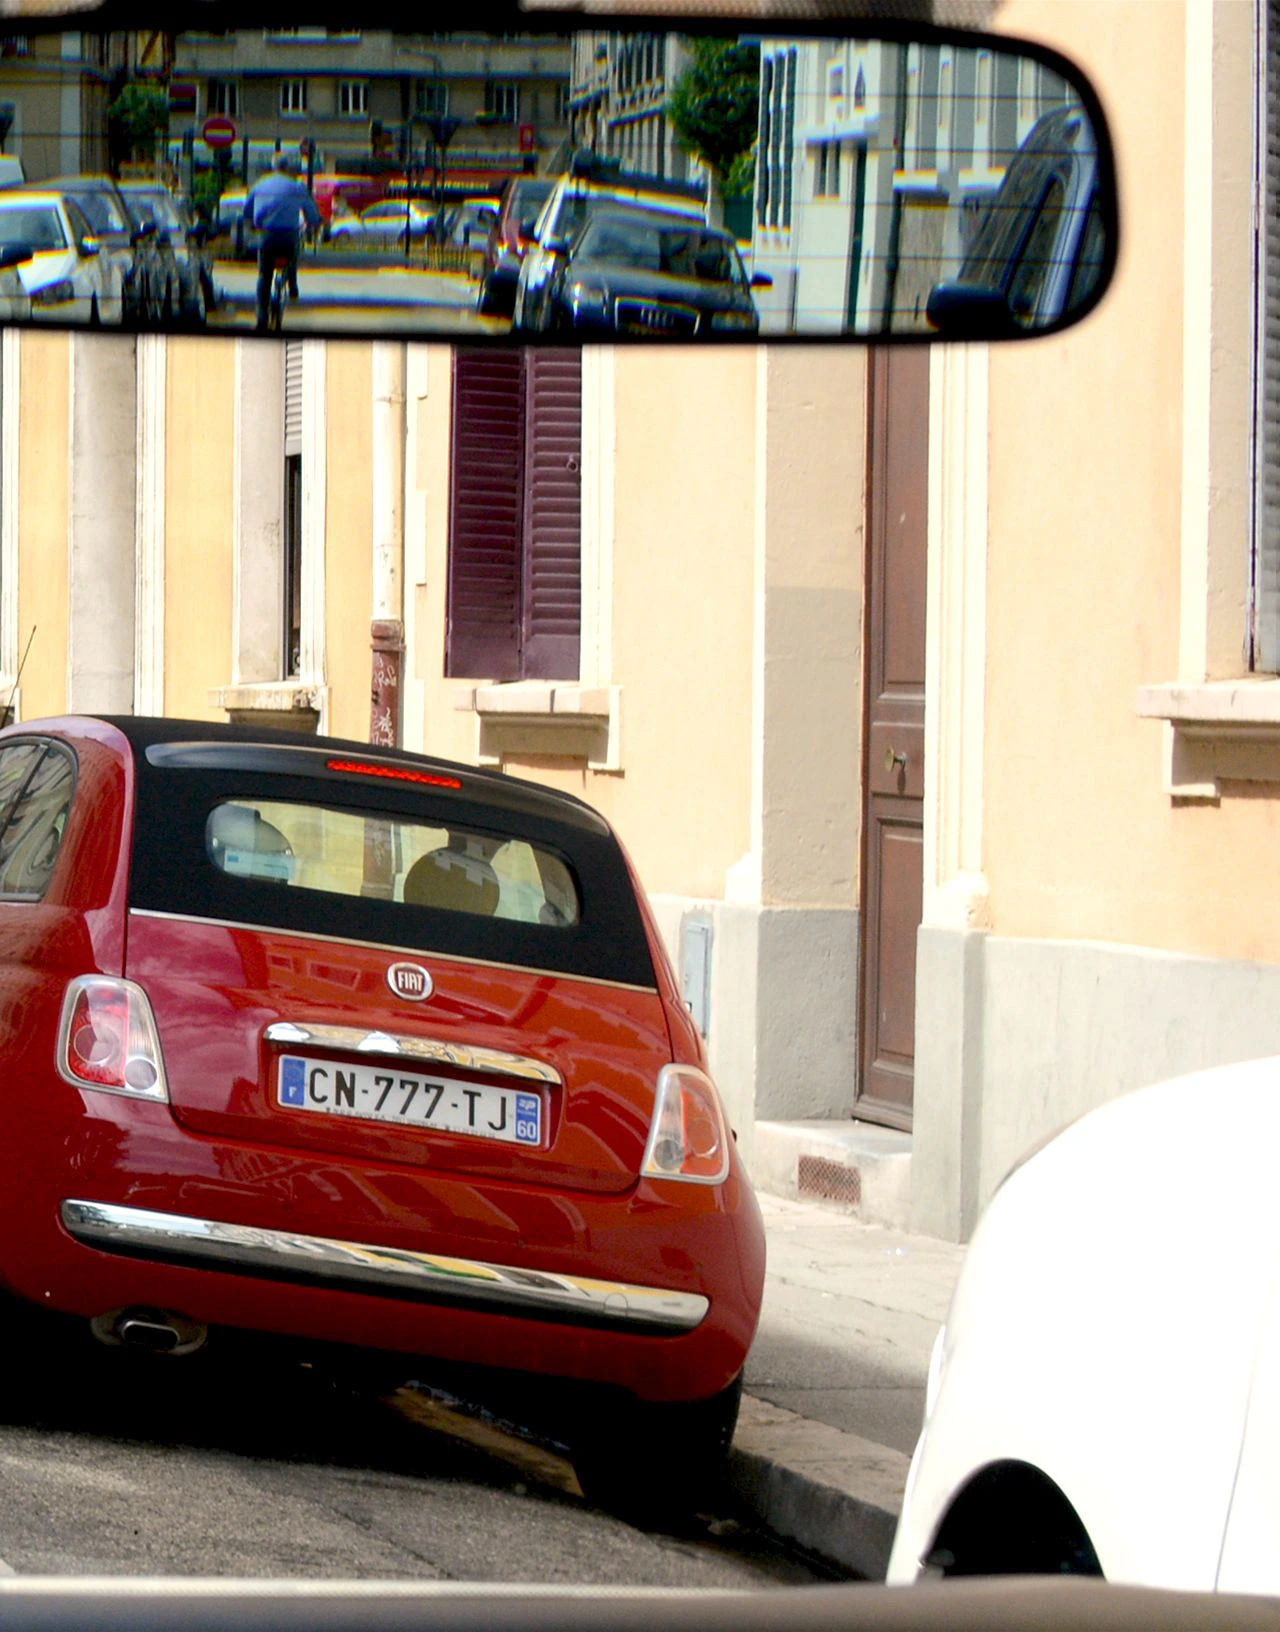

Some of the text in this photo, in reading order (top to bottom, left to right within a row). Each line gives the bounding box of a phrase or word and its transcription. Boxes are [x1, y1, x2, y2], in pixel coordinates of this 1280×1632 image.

[397, 970, 424, 992] FIAT
[308, 1067, 508, 1131] CN-777-TJ
[516, 1121, 537, 1140] 60
